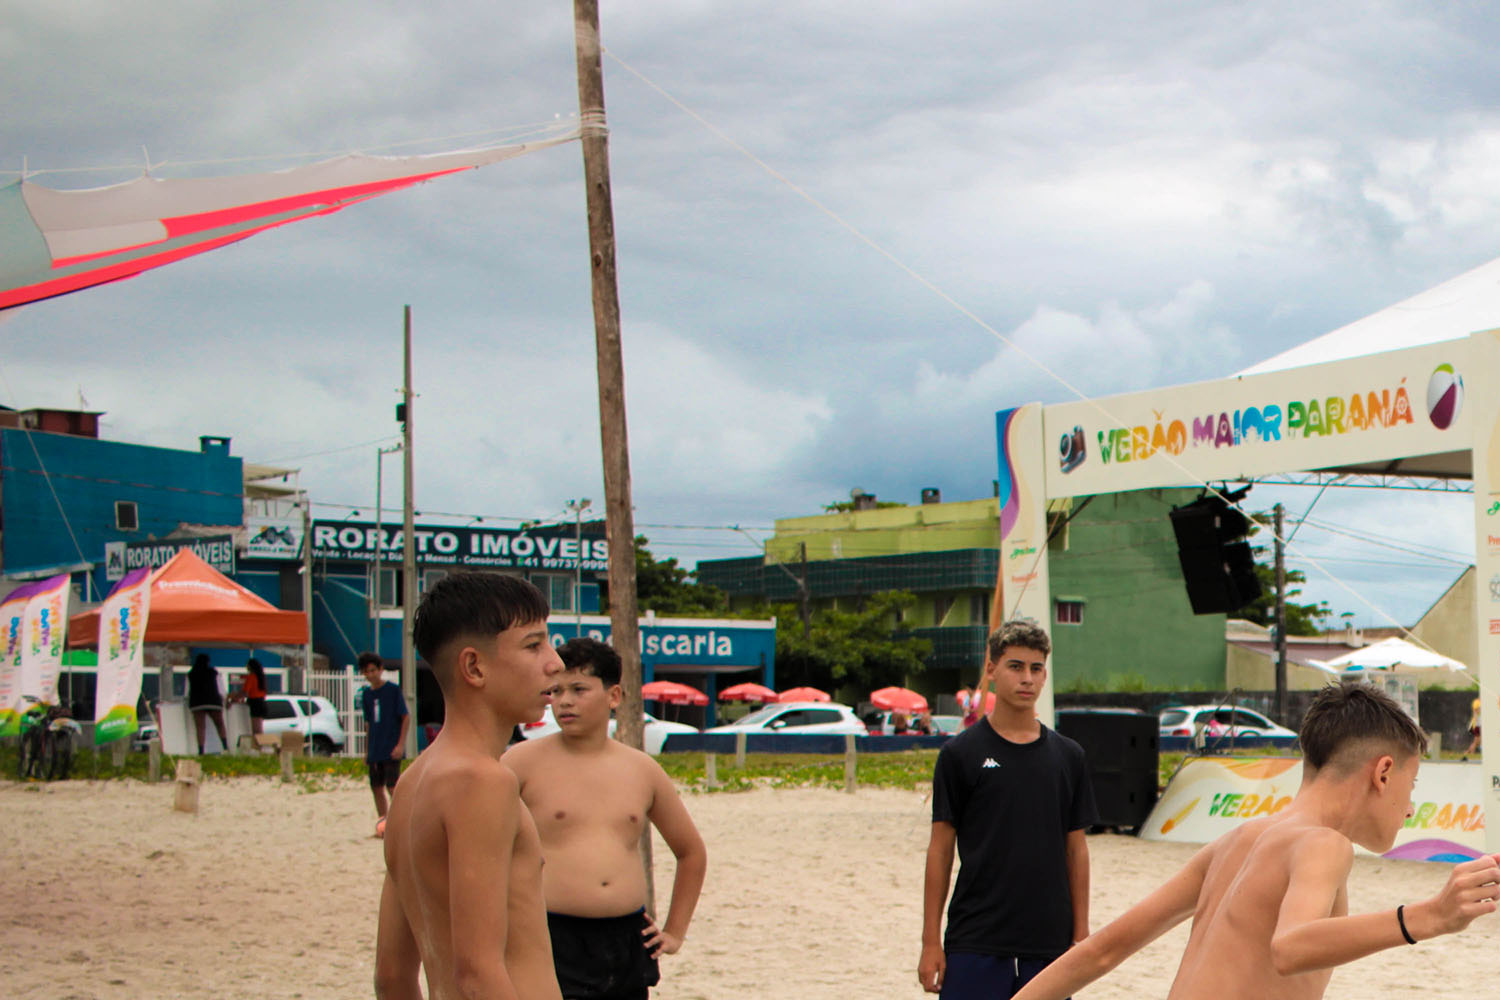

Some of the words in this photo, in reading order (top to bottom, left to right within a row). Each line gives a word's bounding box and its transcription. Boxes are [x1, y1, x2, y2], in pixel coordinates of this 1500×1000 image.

[1097, 409, 1188, 464] VERÃO
[1193, 404, 1282, 449] MAIOR
[1287, 377, 1415, 439] PARANÁ
[470, 531, 609, 560] IMÓVEIS
